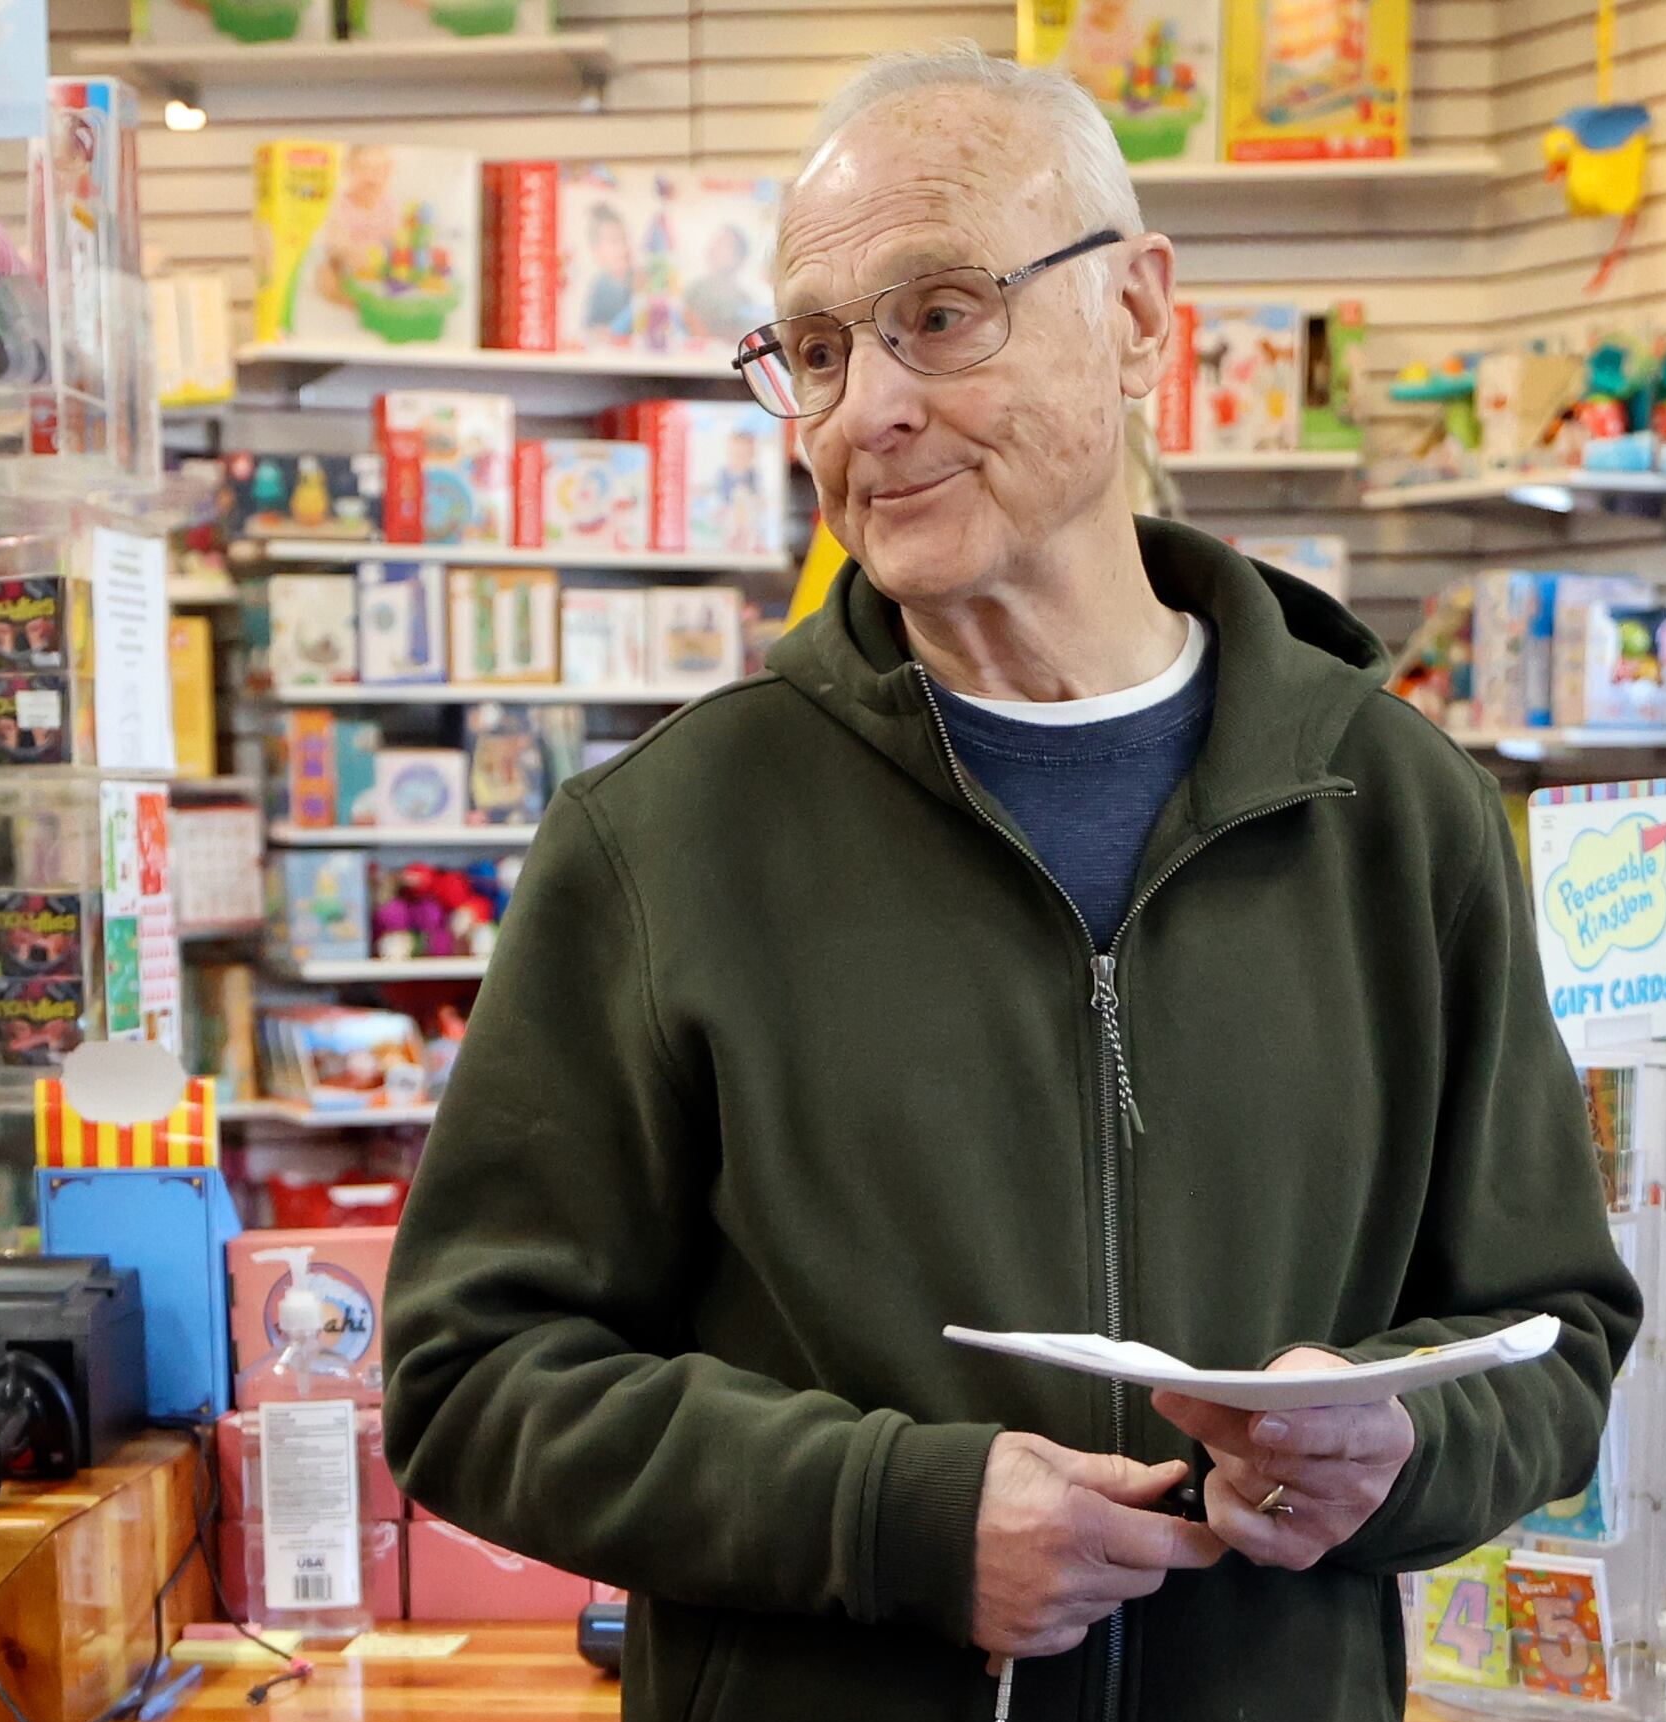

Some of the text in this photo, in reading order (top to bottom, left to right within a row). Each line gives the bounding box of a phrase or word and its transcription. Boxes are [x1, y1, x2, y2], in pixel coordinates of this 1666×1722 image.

[1558, 850, 1658, 916] Peaceable
[1577, 890, 1654, 949] Kingdom
[1553, 982, 1604, 1018] GIFT
[1434, 1578, 1494, 1670] 4
[1533, 1596, 1591, 1679] 5
